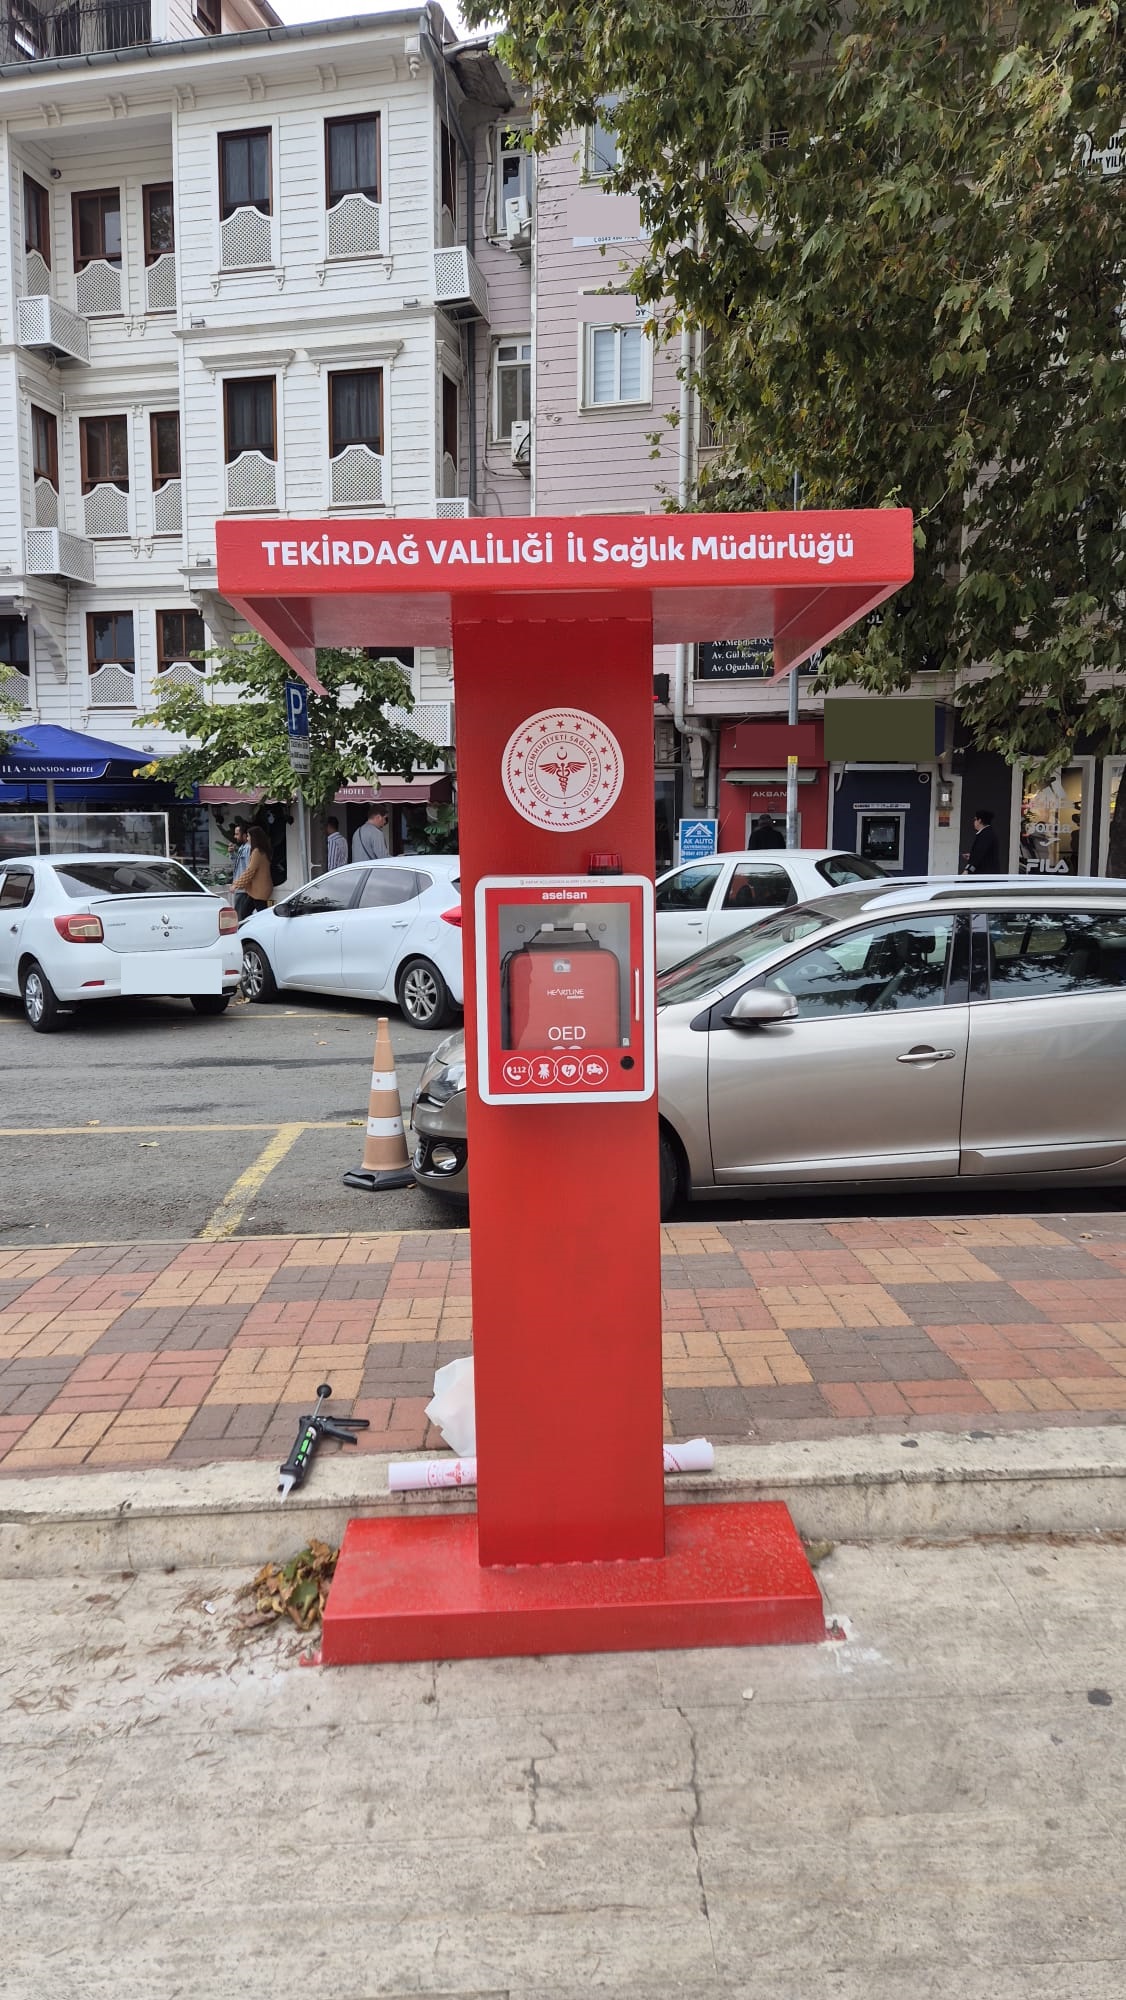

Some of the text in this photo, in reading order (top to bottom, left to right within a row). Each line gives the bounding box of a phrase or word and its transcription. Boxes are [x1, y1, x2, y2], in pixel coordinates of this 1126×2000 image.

[261, 533, 419, 566] TEKİRDAĞ
[567, 531, 587, 563] İl
[593, 536, 685, 568] Sağlık
[691, 532, 854, 565] Müdürlüğü
[712, 652, 724, 660] Av.
[725, 650, 740, 659] Gül
[712, 664, 724, 672] Av.
[725, 662, 760, 674] Oğuzhan
[290, 688, 303, 731] P
[527, 733, 568, 771] CUMHURİYETİ
[569, 735, 594, 756] SAĞLIK
[527, 771, 550, 802] TÜRKİYE
[1026, 859, 1069, 873] FILA
[541, 889, 588, 900] aselsan
[548, 1026, 586, 1041] OED
[513, 1065, 527, 1074] 112
